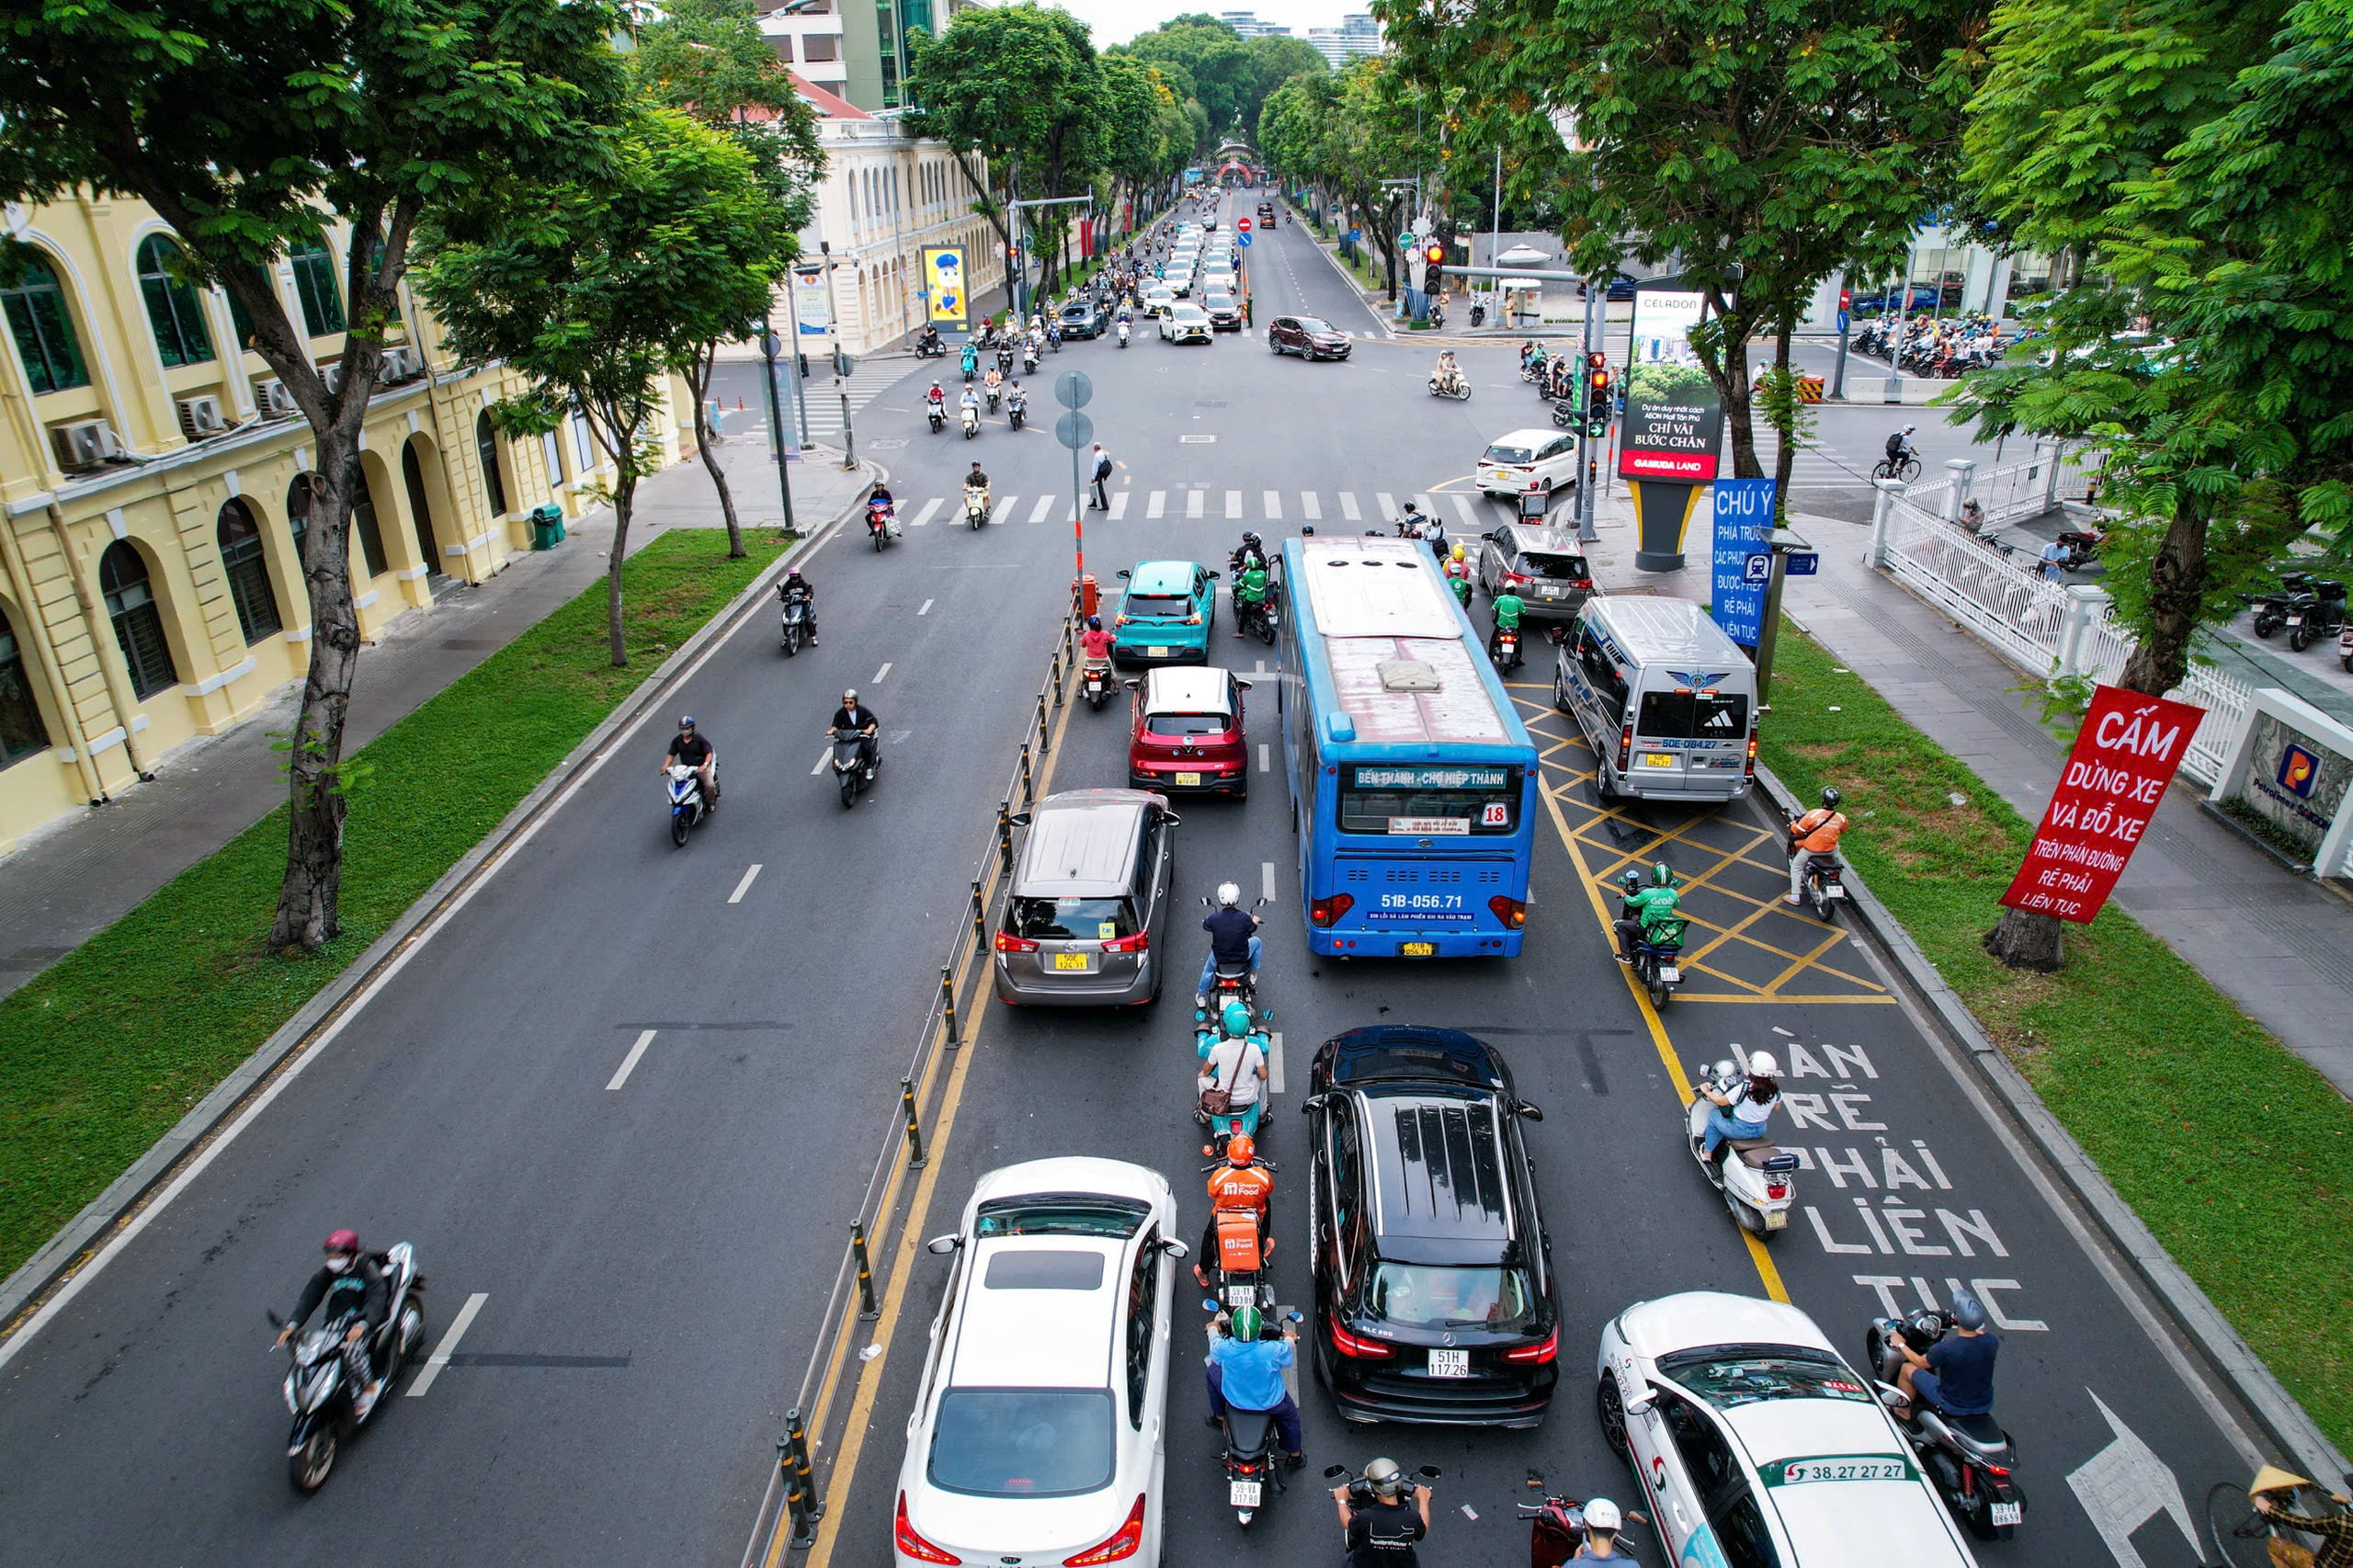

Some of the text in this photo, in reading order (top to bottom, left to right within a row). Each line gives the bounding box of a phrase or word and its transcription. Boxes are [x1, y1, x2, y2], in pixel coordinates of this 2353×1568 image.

[1644, 299, 1697, 309] CELADON
[1674, 423, 1694, 435] VÀI
[1634, 460, 1701, 471] GAMUDA LAND
[1716, 483, 1773, 516] CHÚ Ý
[1718, 521, 1738, 540] PHÍA
[1714, 547, 1727, 565] CÁC
[1717, 574, 1740, 593] ĐƯỢC
[1736, 597, 1756, 616] PHẢI
[1741, 624, 1756, 642] TỤC
[2096, 705, 2180, 761] CẤM
[1662, 739, 1718, 749] 50E-084.27
[1358, 768, 1378, 785] BẾN
[1472, 768, 1504, 785] THÀNH
[2066, 759, 2163, 804] DỪNG XE
[2253, 778, 2295, 810] Petrolimex
[1485, 806, 1504, 822] 18
[2052, 800, 2144, 842] VÀ ĐỖ XE
[2034, 838, 2059, 859] TRÊN
[2086, 848, 2125, 872] ĐƯỜNG
[2058, 872, 2093, 893] PHẢI
[1381, 894, 1461, 908] 51B-056.71
[1650, 896, 1674, 905] Grab
[2020, 892, 2081, 916] LIÊN TỤC
[1781, 1084, 1888, 1131] RẼ
[1438, 1352, 1460, 1363] 51H
[1430, 1364, 1467, 1376] 117.26
[1813, 1465, 1902, 1479] 38.27 27 27
[1234, 1483, 1257, 1494] 59-VA
[1233, 1494, 1258, 1505] 317.80
